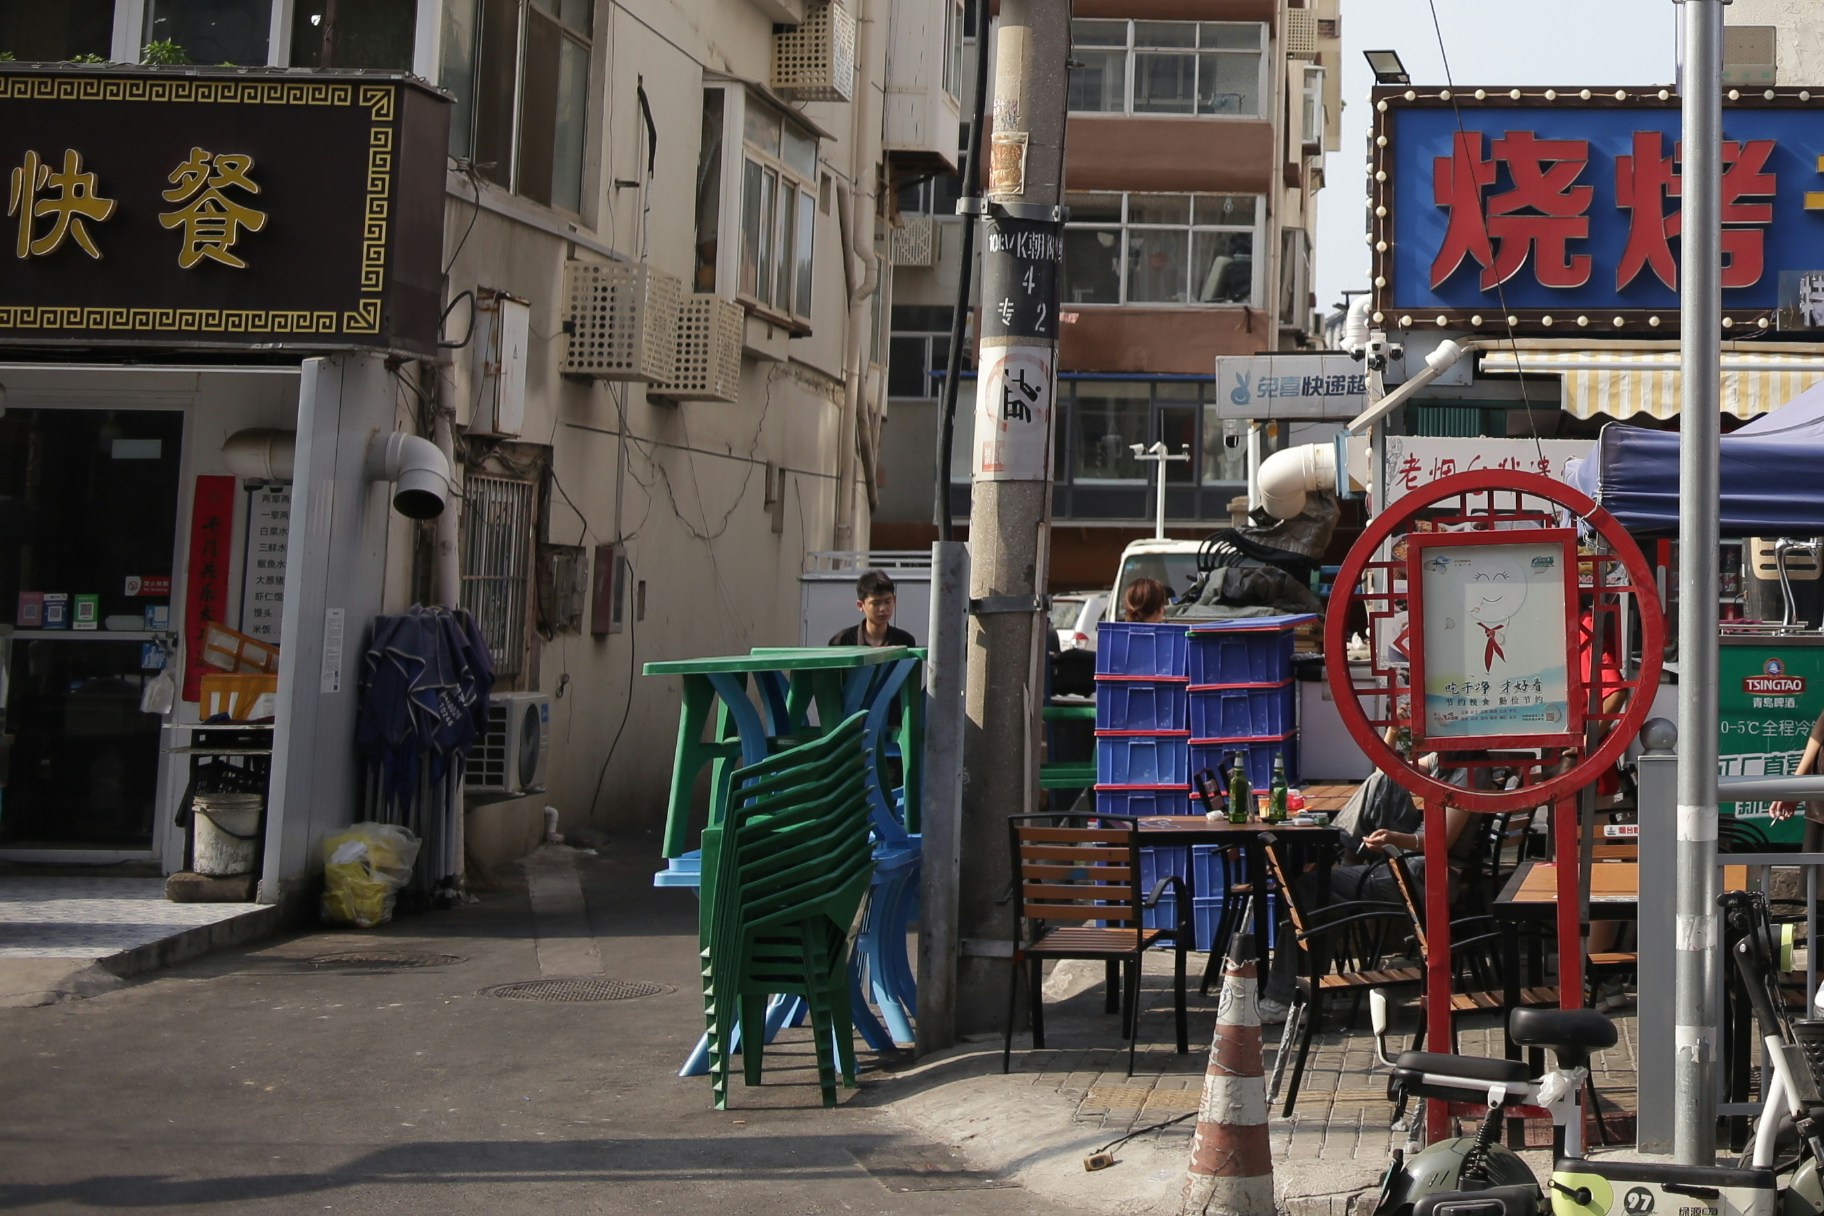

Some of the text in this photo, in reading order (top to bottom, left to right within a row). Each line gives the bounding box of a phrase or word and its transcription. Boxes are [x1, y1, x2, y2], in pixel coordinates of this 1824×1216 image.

[8, 146, 269, 271] 快餐
[1429, 129, 1778, 292] 烧烤
[1021, 265, 1036, 295] 4
[997, 297, 1047, 333] 专 2
[1445, 678, 1544, 696] 吃干净 才好看
[1745, 679, 1803, 691] TSINGTAO
[1752, 697, 1796, 709] 青岛啤酒
[1720, 719, 1818, 738] 0-5℃全程冷
[1627, 1192, 1652, 1211] 97
